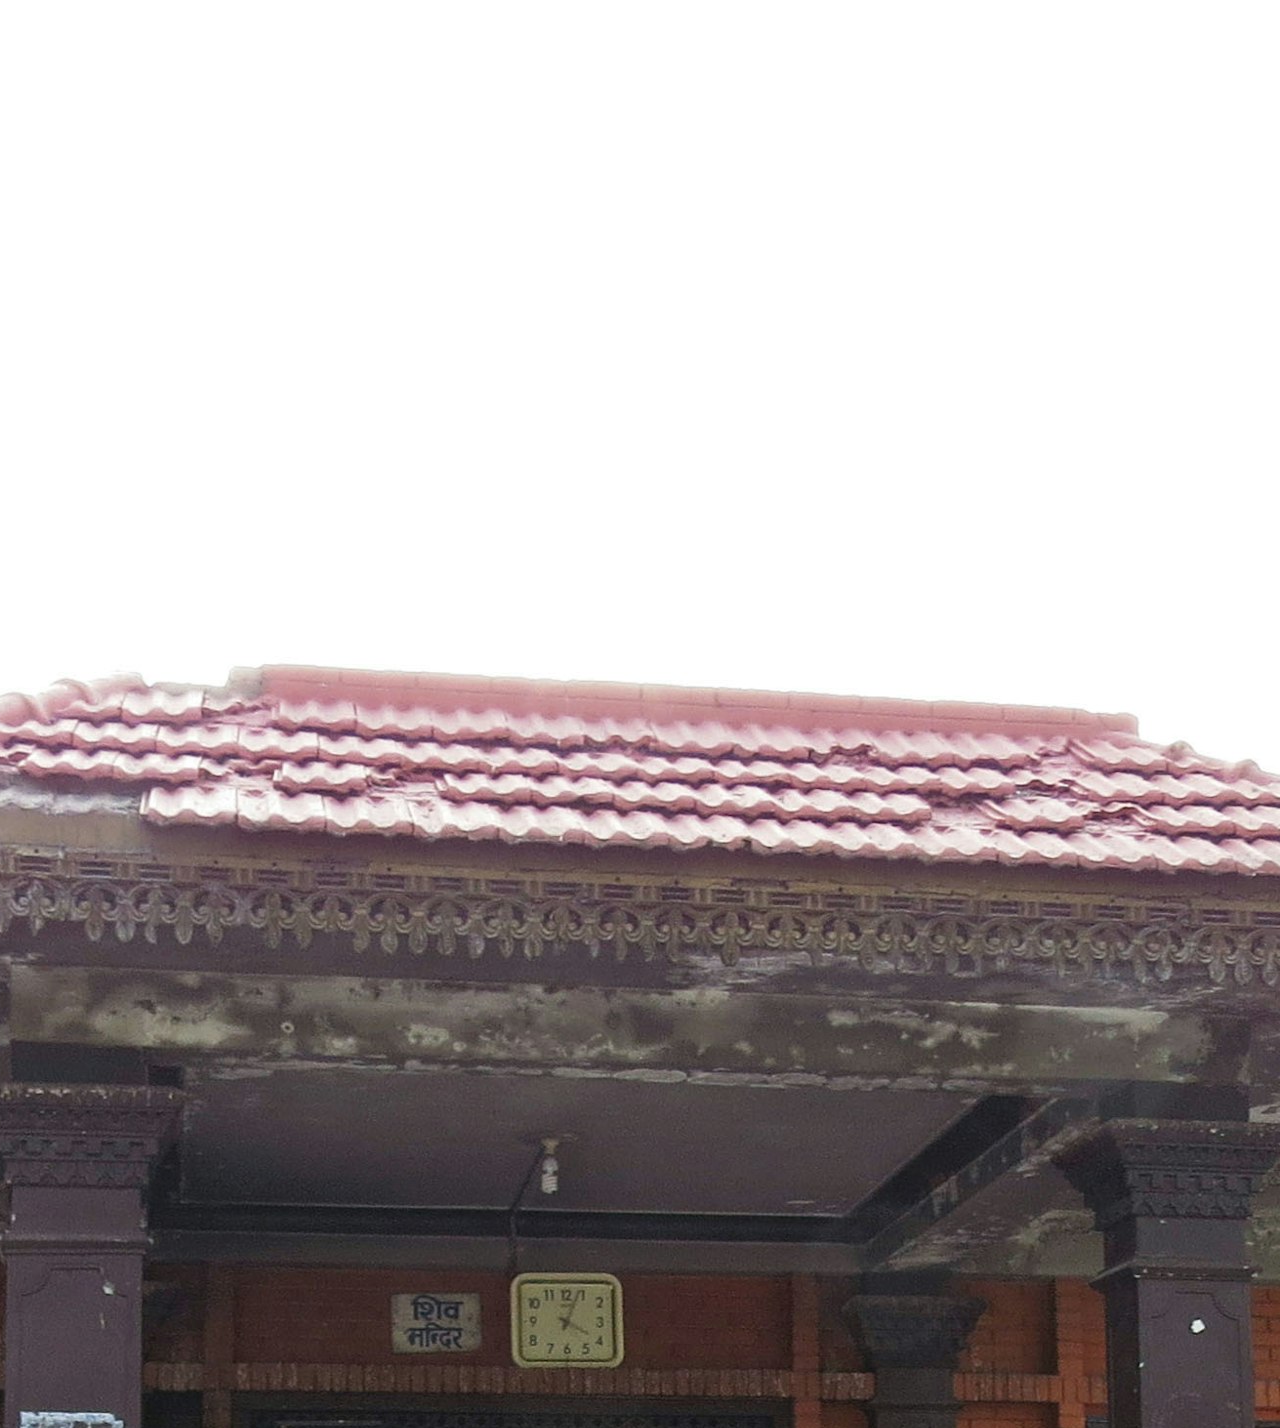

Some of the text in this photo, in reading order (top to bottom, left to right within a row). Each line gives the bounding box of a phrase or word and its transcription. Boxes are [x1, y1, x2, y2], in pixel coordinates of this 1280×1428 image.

[544, 1289, 555, 1301] 11
[561, 1289, 572, 1301] 12
[411, 1295, 464, 1320] शिव
[528, 1298, 540, 1309] 10
[407, 1322, 464, 1349] मन्दिर
